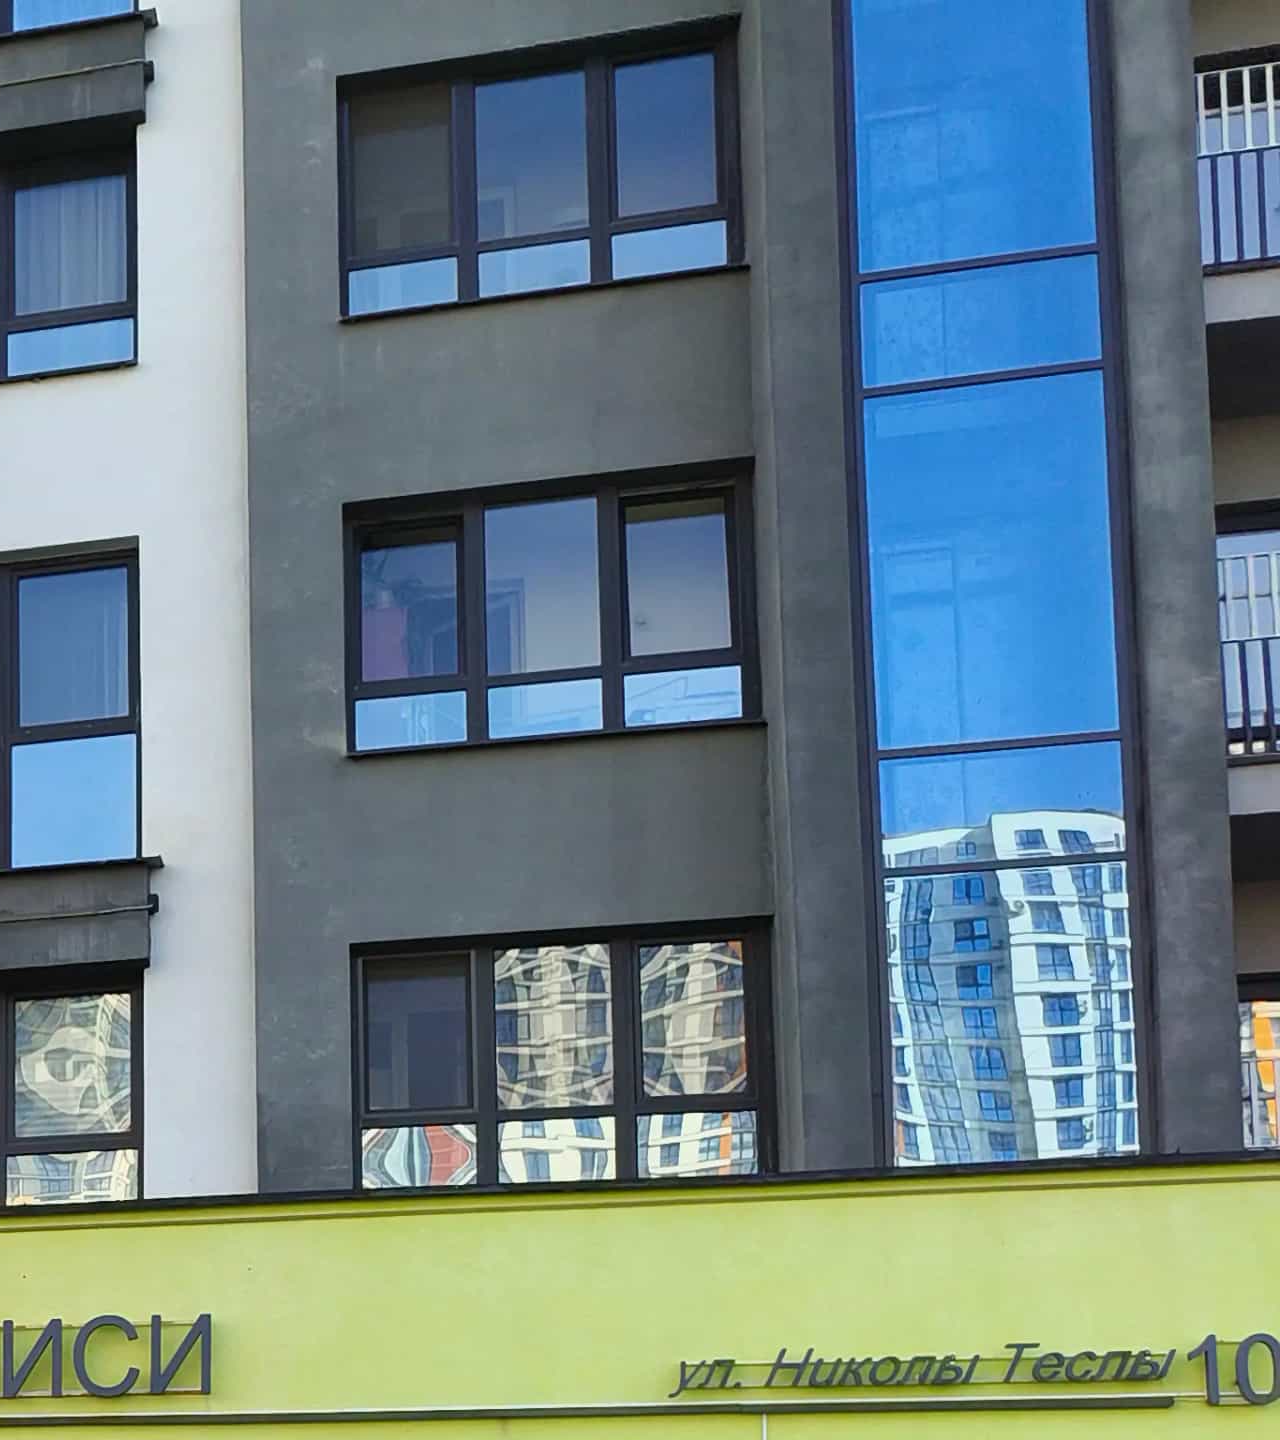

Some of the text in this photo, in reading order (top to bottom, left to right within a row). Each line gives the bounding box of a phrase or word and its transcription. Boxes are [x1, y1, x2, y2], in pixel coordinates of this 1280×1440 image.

[668, 1333, 1280, 1406] ул. Николы Теслы 10
